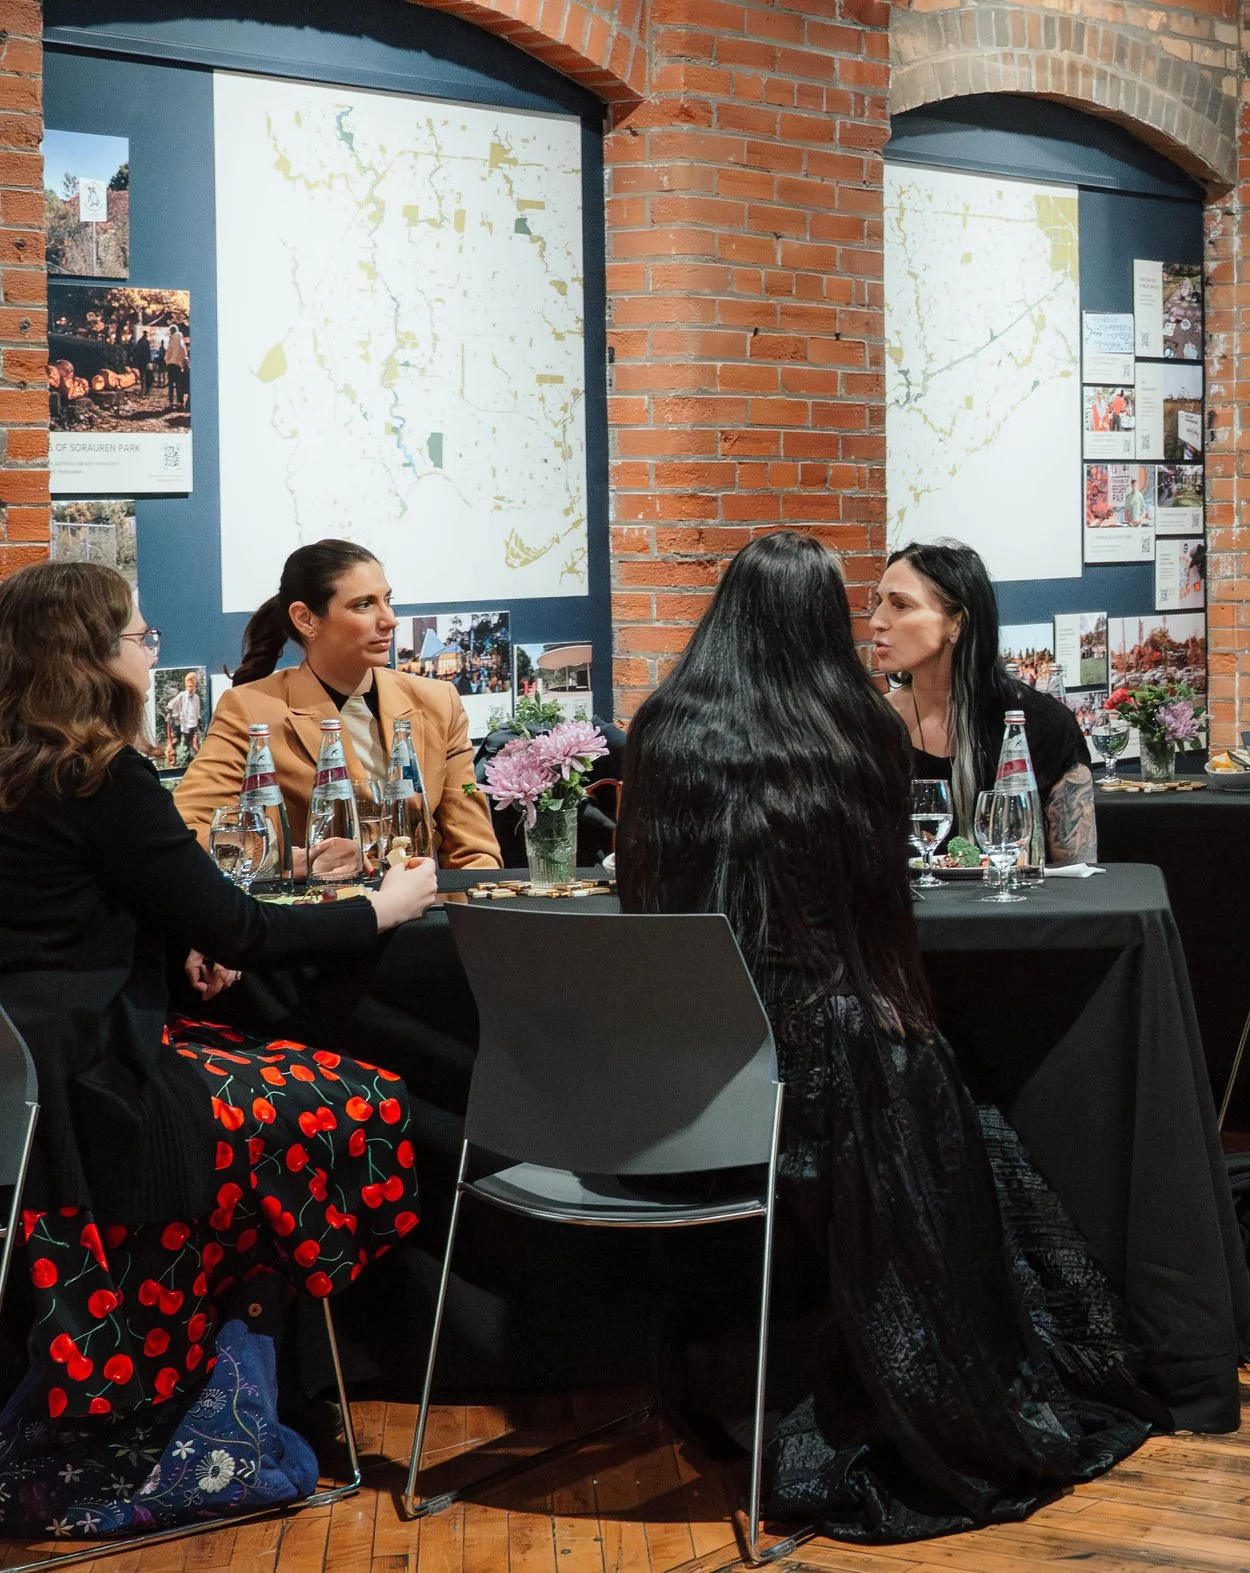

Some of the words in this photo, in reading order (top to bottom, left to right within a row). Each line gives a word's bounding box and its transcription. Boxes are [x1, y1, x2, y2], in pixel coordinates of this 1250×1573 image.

[55, 443, 67, 452] OF
[70, 443, 117, 452] SORAUREN
[119, 443, 141, 452] PARK
